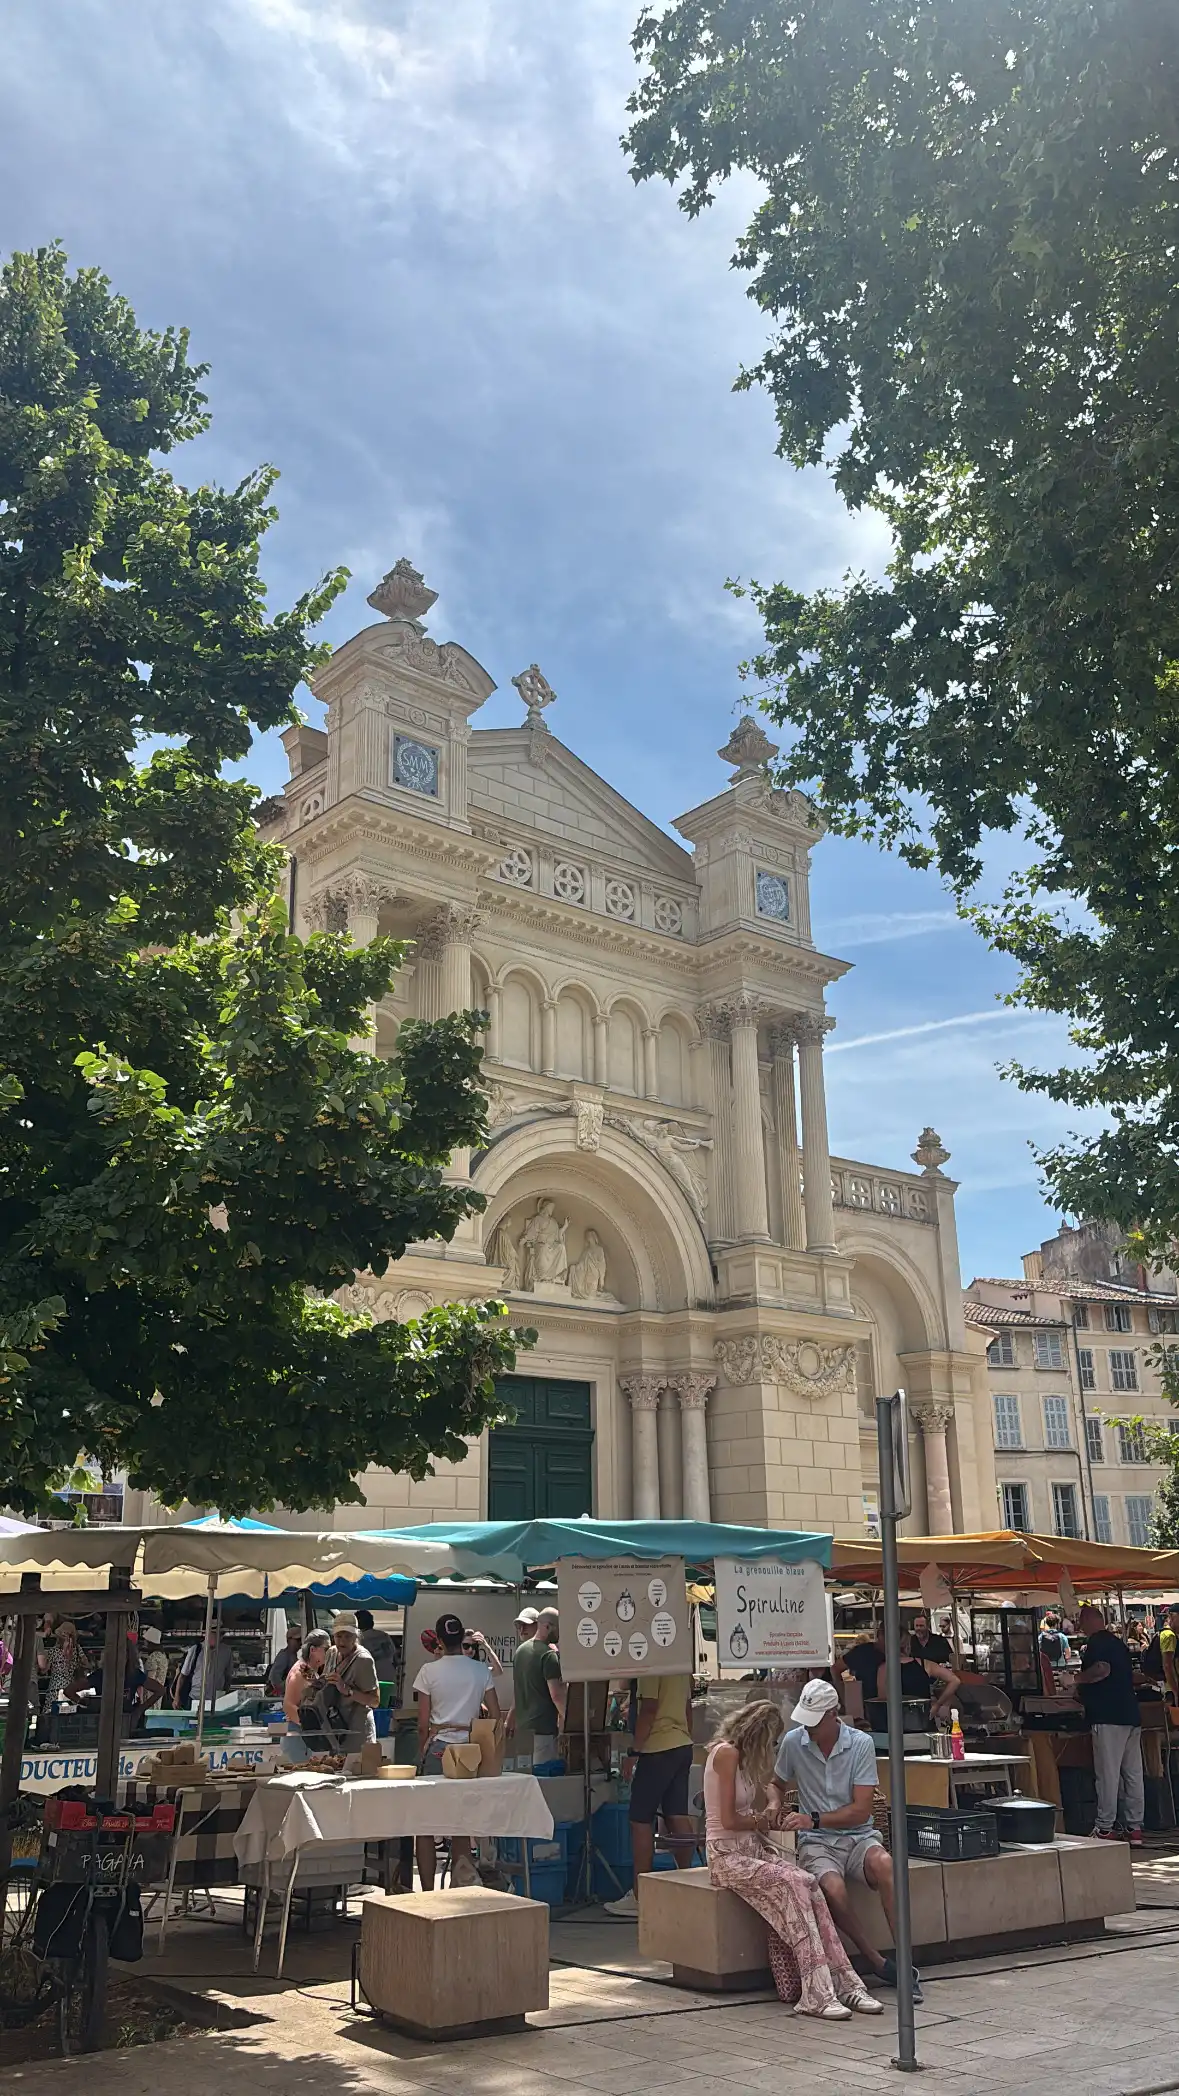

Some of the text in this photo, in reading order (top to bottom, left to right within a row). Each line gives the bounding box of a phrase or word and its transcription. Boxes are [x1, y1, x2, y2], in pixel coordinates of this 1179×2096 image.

[734, 1565, 743, 1574] La
[746, 1565, 784, 1576] grenouille
[736, 1585, 805, 1629] Spiruline
[20, 1758, 98, 1780] DUCTEU
